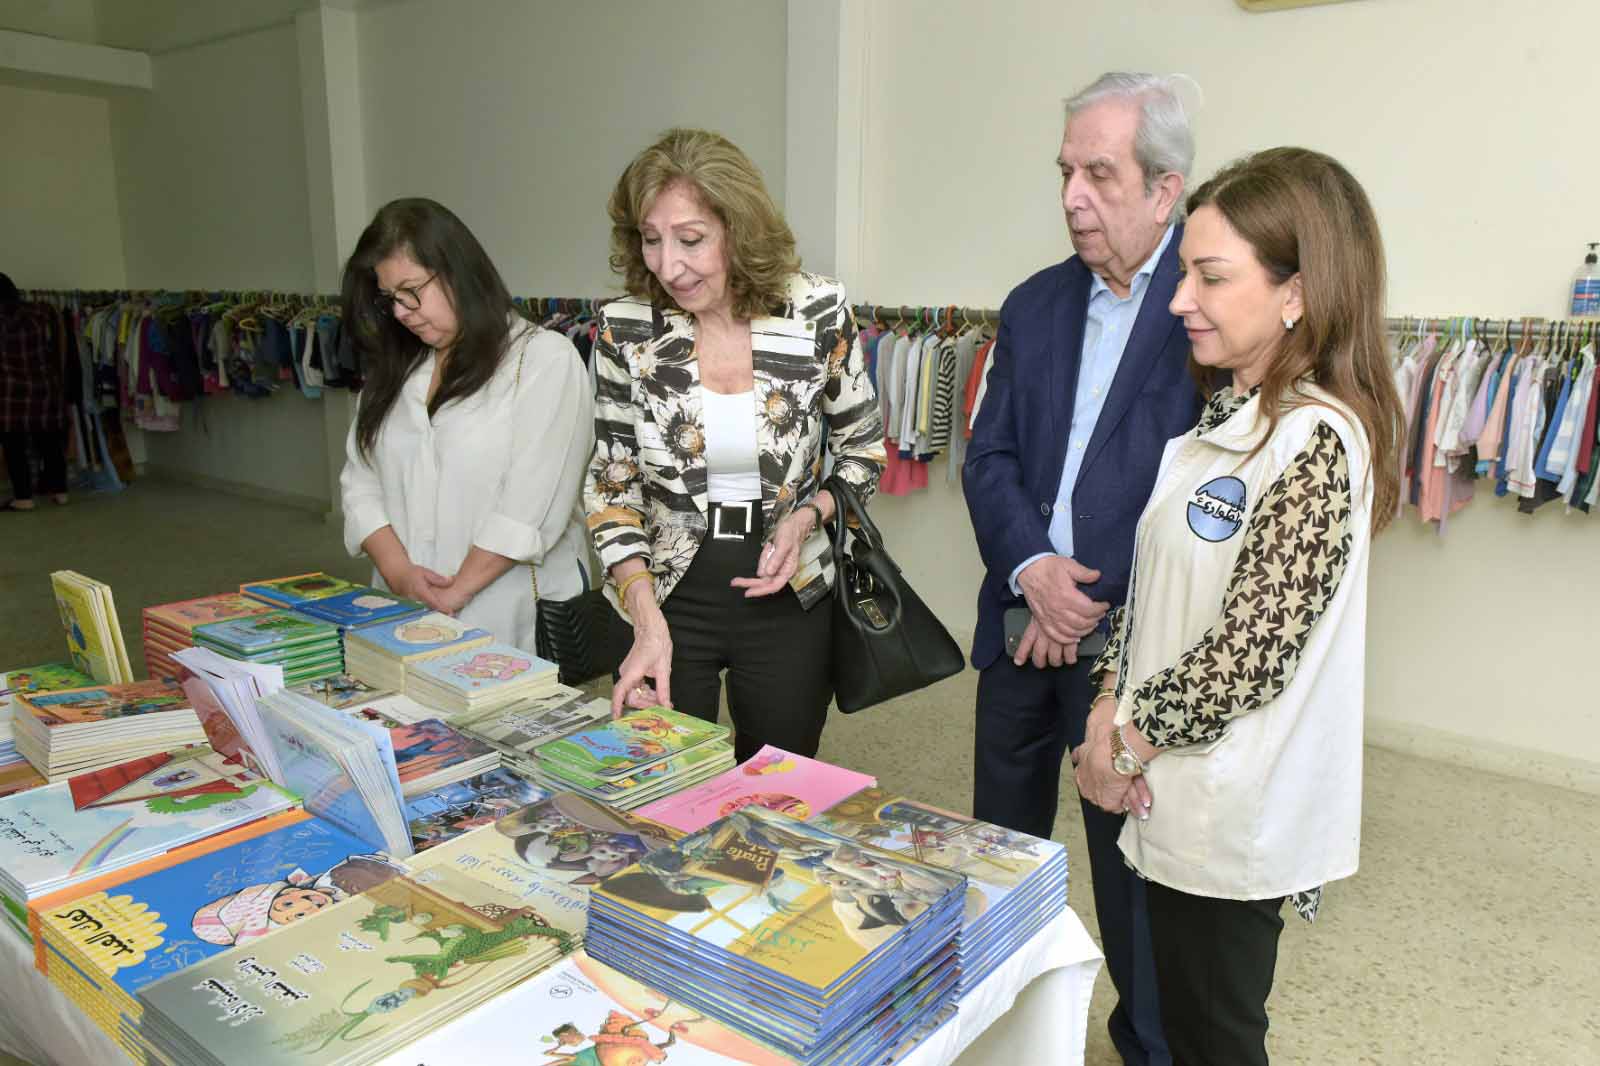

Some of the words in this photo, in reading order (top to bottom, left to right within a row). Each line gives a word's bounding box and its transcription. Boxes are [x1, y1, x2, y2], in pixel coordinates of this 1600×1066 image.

[727, 846, 771, 871] Pirate
[56, 908, 104, 930] كعك
[83, 930, 135, 957] العيد
